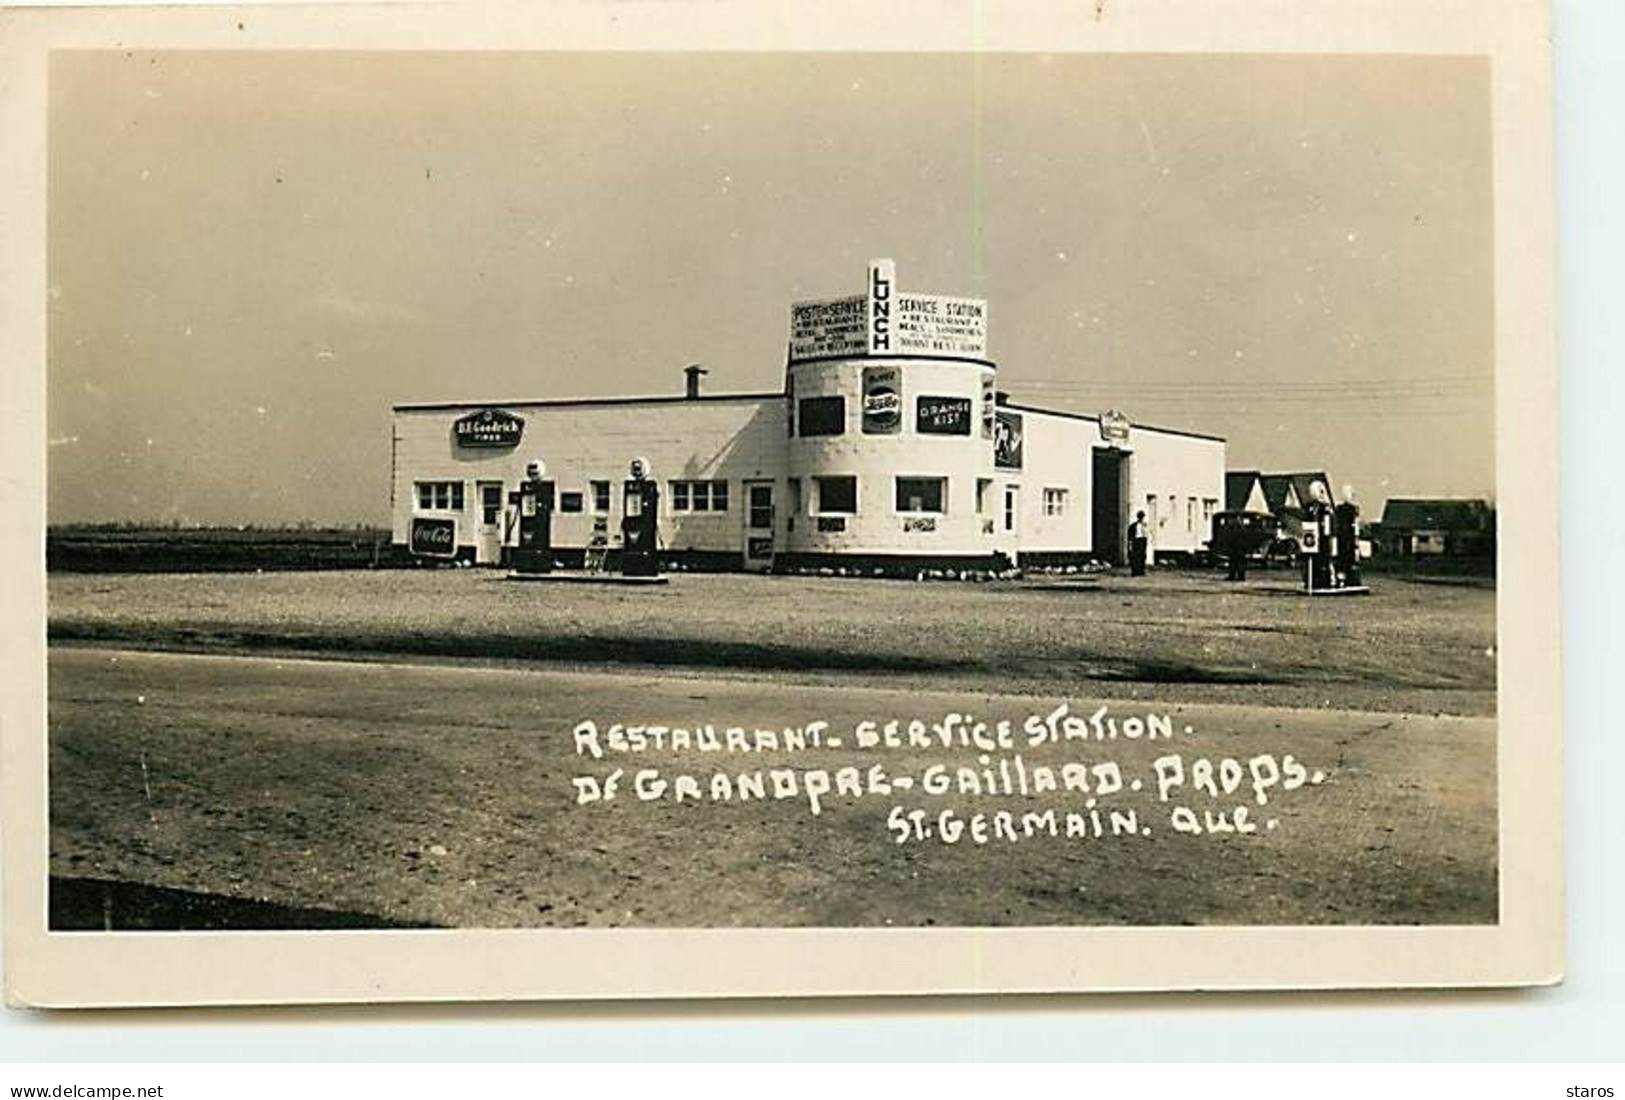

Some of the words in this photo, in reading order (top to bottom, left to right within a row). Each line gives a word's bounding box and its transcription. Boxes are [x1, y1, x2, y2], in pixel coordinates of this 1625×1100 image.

[873, 267, 889, 350] LUNCH
[899, 299, 936, 314] SERVICE
[946, 303, 982, 318] STATION
[920, 402, 969, 417] ORANGE
[934, 413, 960, 426] KIST
